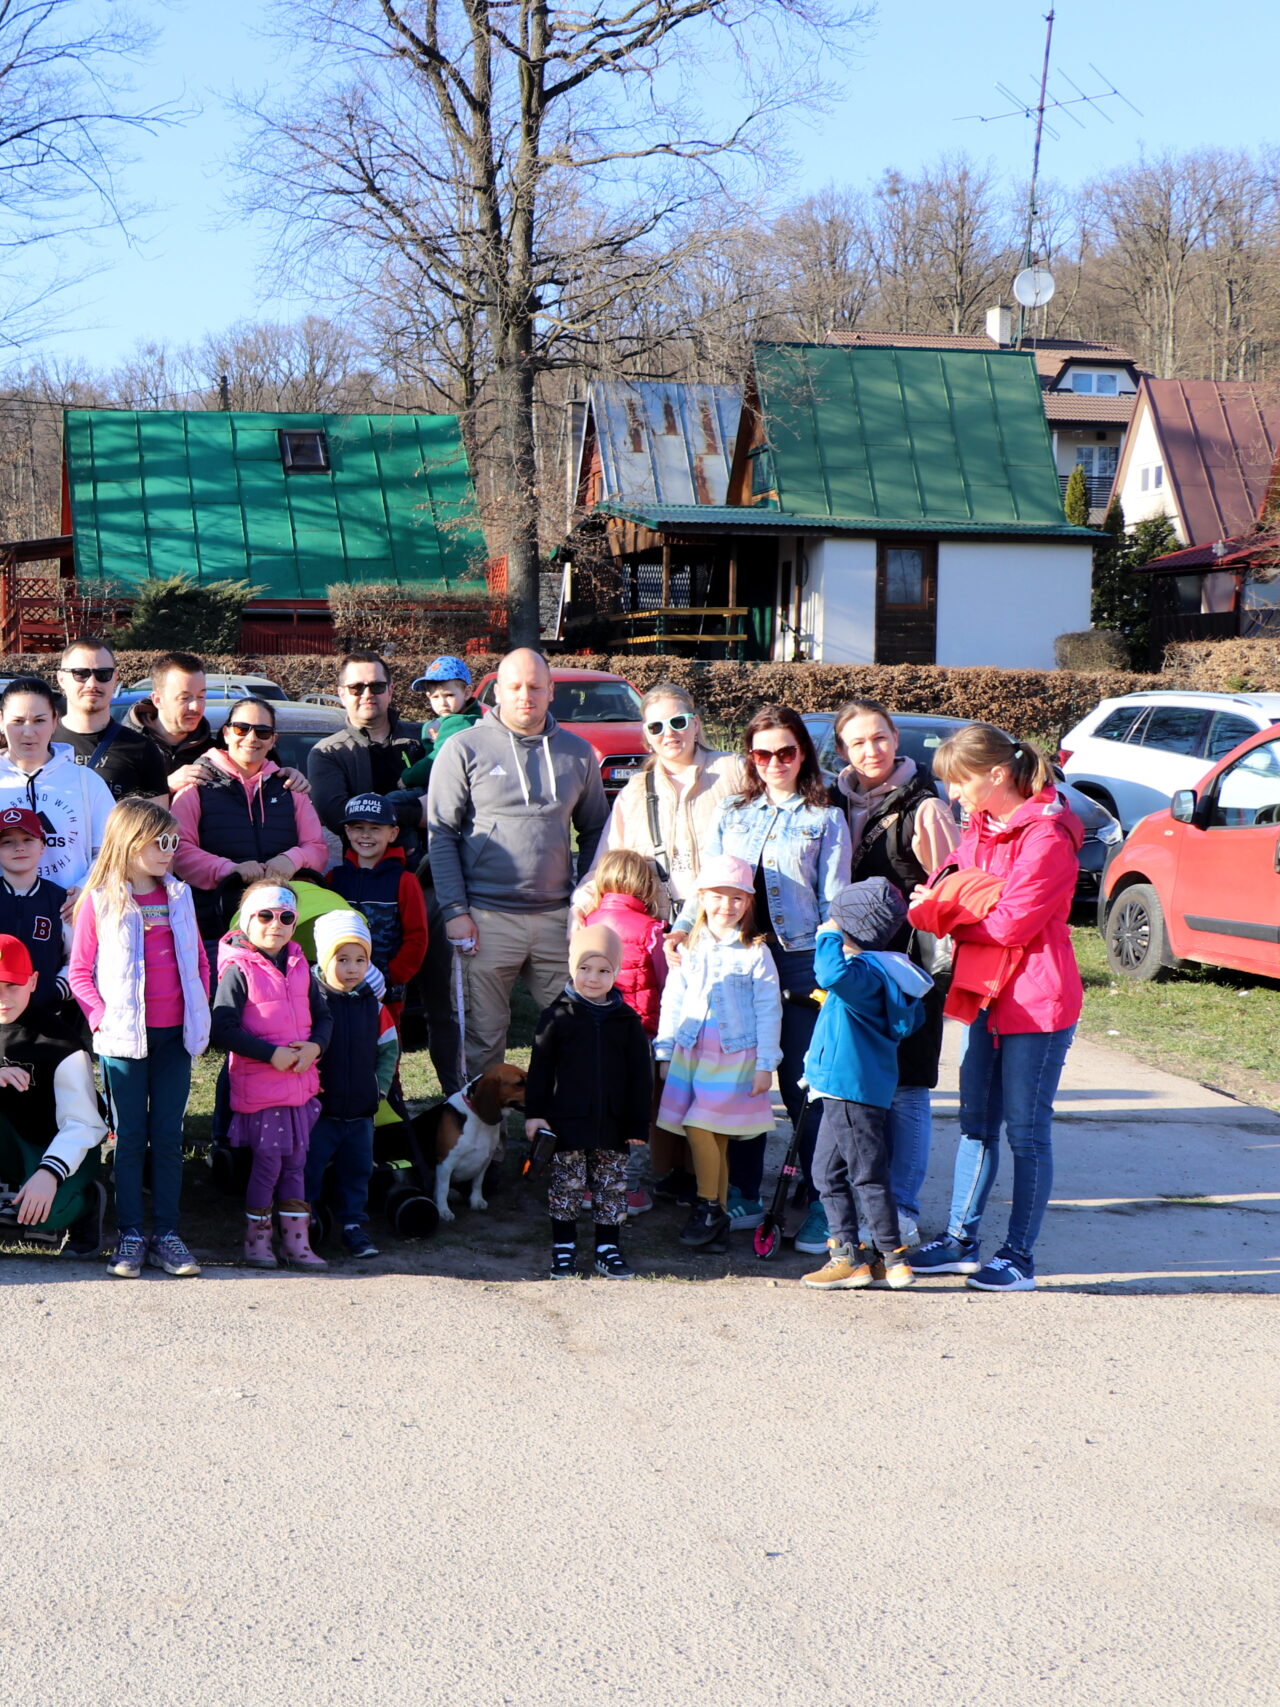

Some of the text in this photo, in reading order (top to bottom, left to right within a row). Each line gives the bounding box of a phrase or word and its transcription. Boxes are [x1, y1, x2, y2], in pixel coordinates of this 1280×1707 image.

[54, 798, 77, 823] WITH
[349, 804, 382, 814] AIRRACE
[362, 799, 382, 807] BULL
[32, 915, 52, 941] B
